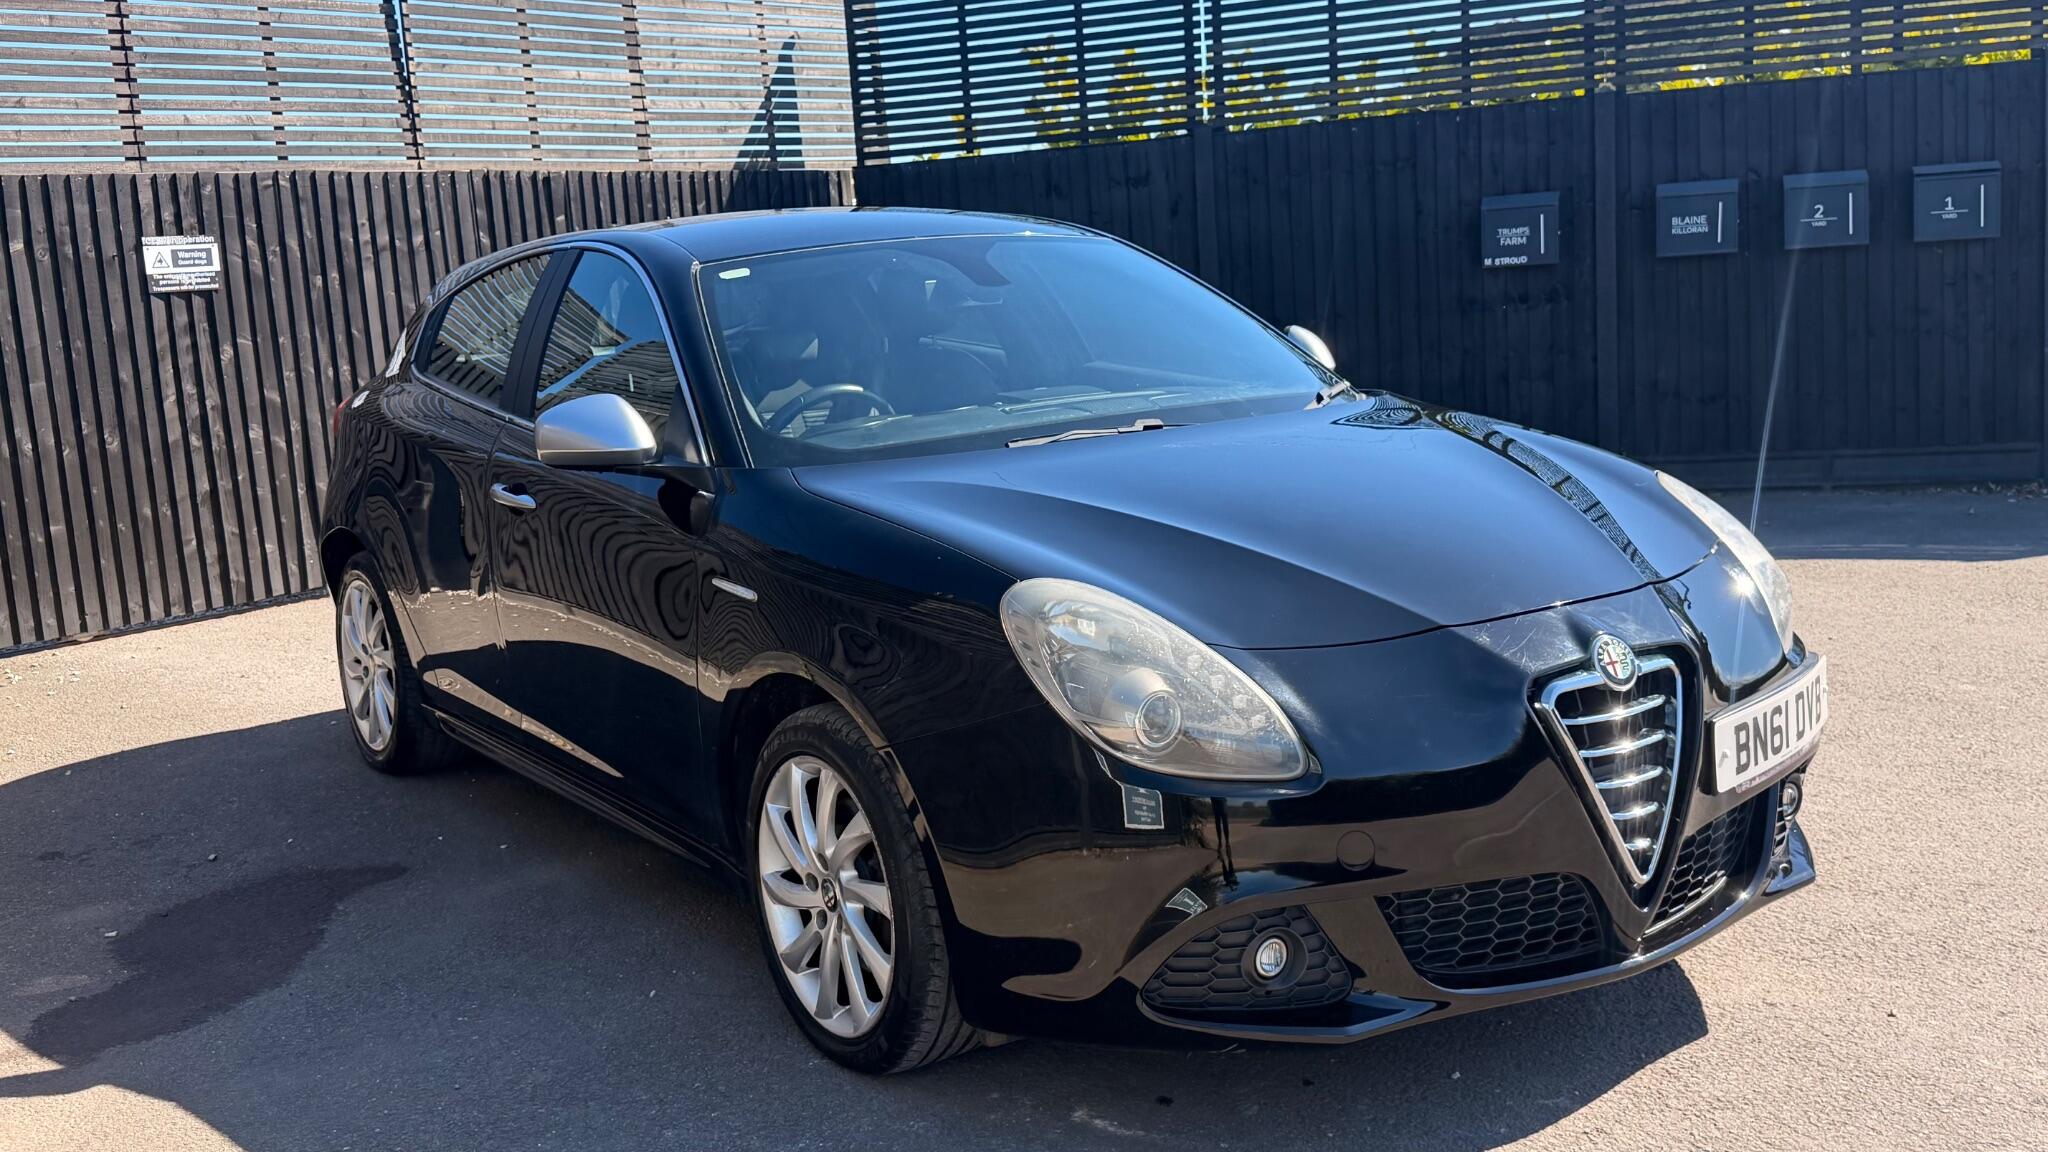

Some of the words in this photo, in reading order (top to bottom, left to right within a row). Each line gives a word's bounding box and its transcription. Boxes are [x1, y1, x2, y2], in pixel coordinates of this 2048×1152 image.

[1944, 196, 1955, 211] 1
[1813, 204, 1825, 219] 2
[1671, 215, 1708, 225] BLAINE
[1496, 226, 1530, 237] TRUMPS
[1671, 225, 1709, 235] KILLORAN
[1500, 236, 1527, 246] FARM
[177, 251, 206, 259] Warning
[1484, 257, 1492, 266] M
[1494, 256, 1528, 266] STROUD
[1734, 699, 1790, 776] BN61
[1795, 675, 1822, 742] DVB
